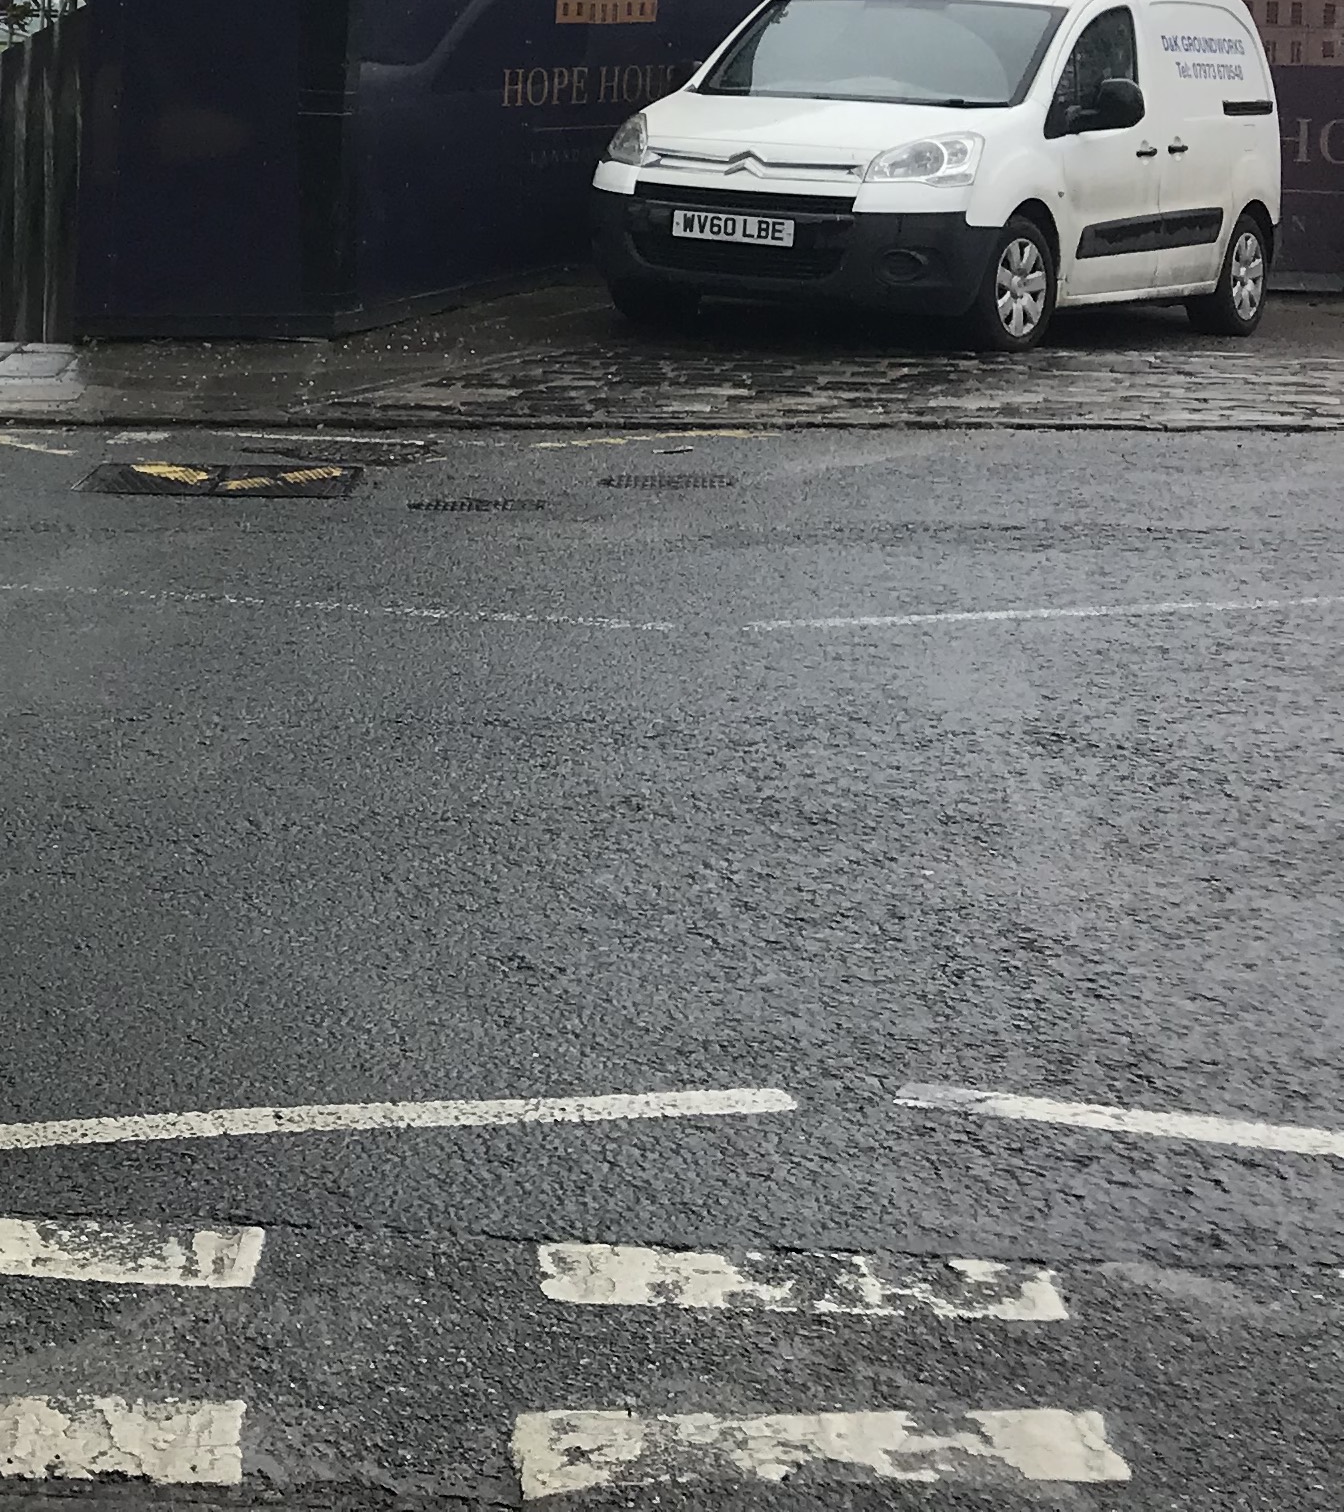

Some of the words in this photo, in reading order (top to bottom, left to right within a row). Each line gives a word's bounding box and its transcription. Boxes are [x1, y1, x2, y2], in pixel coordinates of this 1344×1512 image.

[1181, 36, 1246, 55] GROUNDWORKS
[502, 66, 589, 107] HOPE
[683, 213, 736, 236] WV60
[742, 218, 785, 241] LBE
